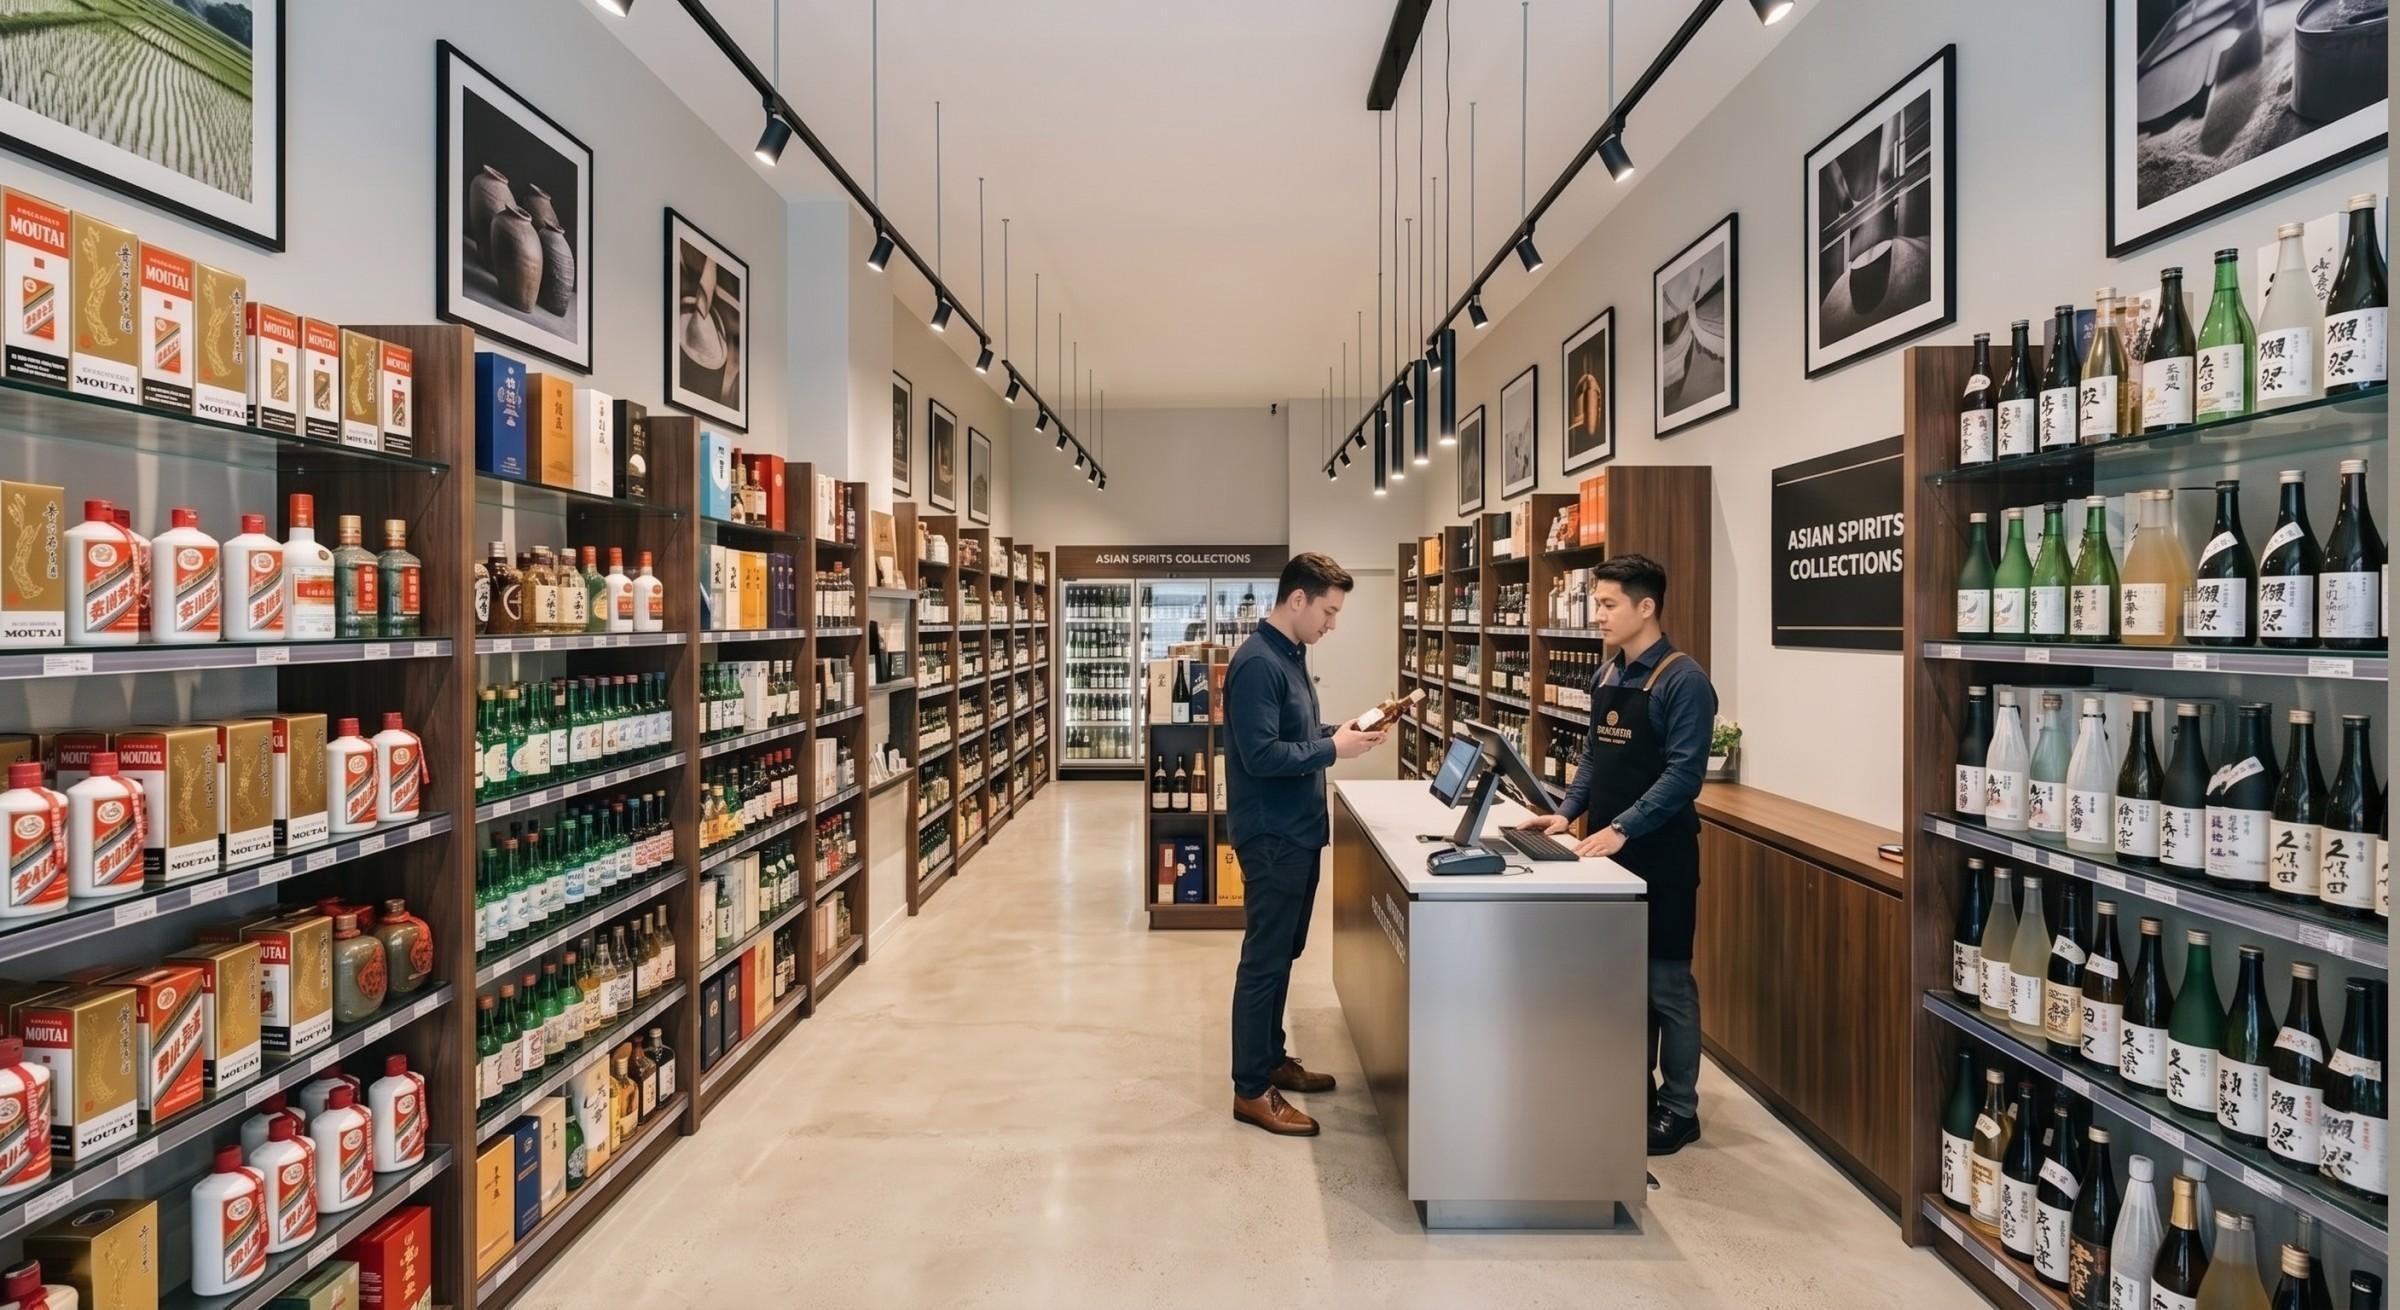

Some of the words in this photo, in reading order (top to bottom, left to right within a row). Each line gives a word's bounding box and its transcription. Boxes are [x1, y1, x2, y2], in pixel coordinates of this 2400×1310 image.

[9, 214, 66, 249] MOUTAI
[145, 264, 190, 292] MOUTAI
[75, 375, 136, 395] MOUTAI
[1788, 524, 1833, 550] ASIAN
[1838, 513, 1904, 544] SPIRITS
[1096, 554, 1129, 563] ASIAN
[1132, 554, 1173, 564] SPIRITS
[1175, 554, 1251, 564] COLLECTIONS
[1789, 548, 1903, 580] COLLECTIONS
[5, 629, 62, 638] MOUTAI
[25, 1027, 68, 1043] MOUTAI
[80, 1117, 136, 1149] MOUTAI
